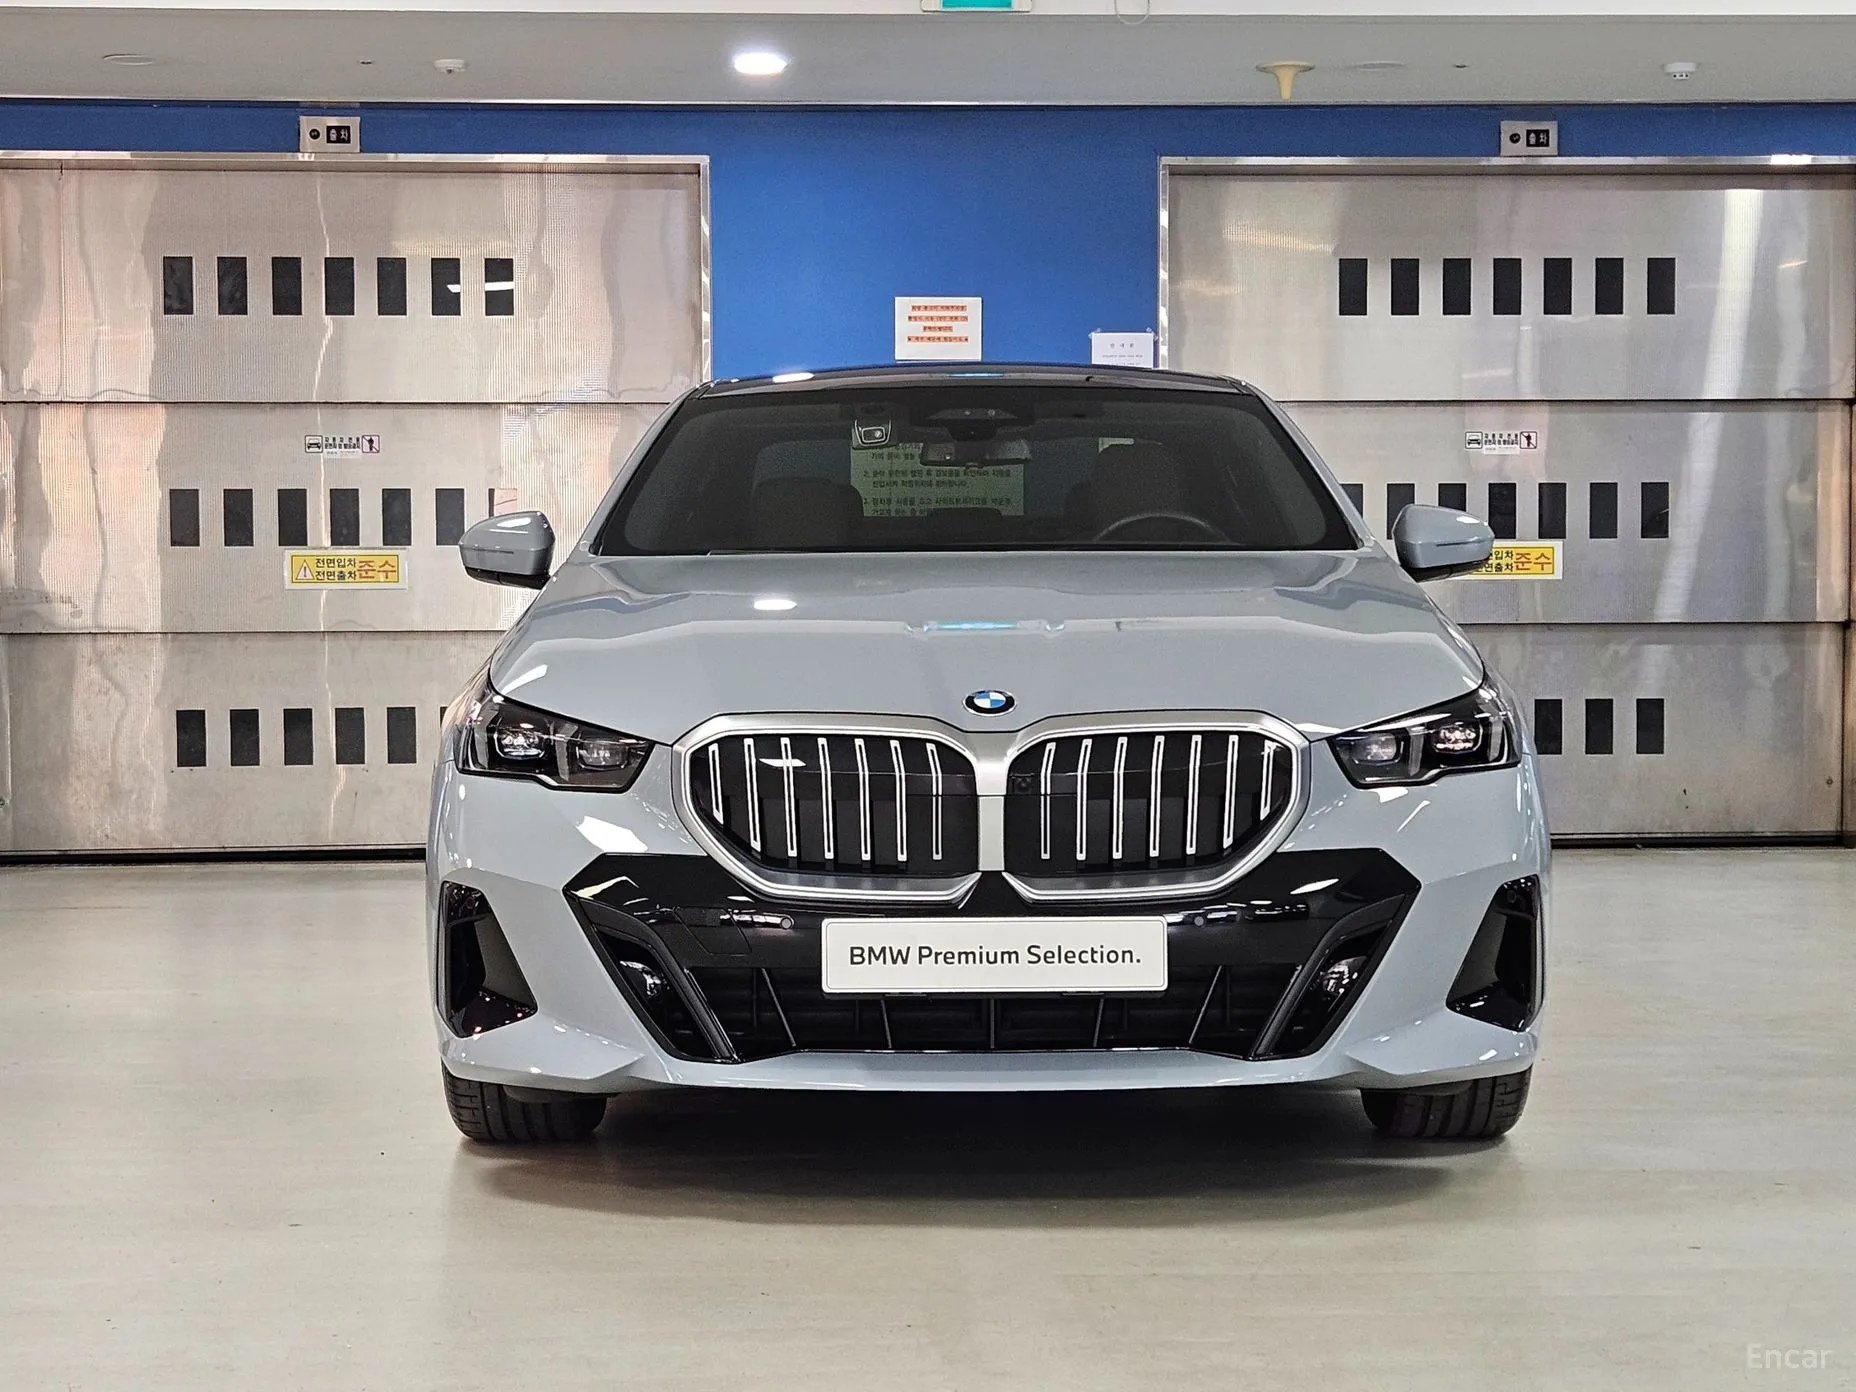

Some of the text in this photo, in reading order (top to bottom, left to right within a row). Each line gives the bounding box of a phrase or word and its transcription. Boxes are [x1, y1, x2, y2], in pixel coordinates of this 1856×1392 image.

[315, 558, 356, 569] 전면입차
[357, 560, 397, 579] 준수
[1514, 552, 1552, 571] 준수
[315, 570, 357, 581] 전면출차
[849, 944, 1142, 965] BMW Premium Selection.
